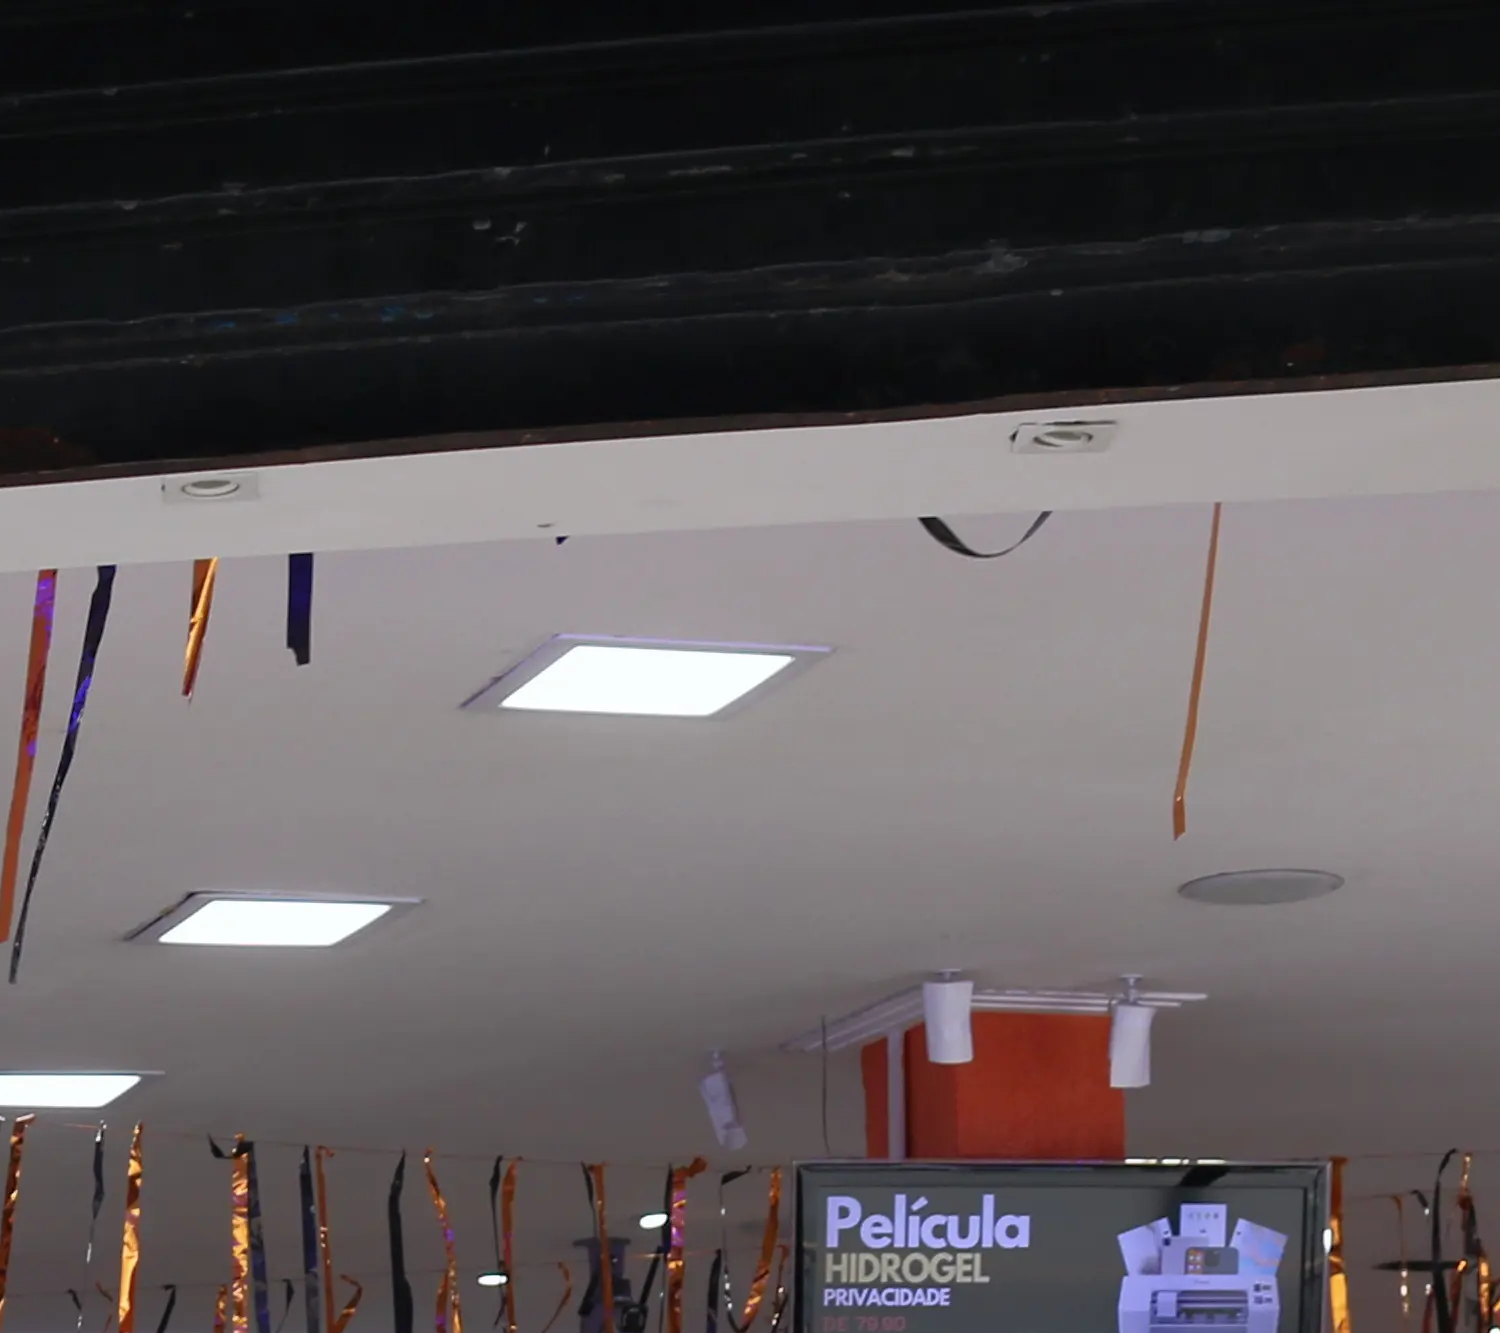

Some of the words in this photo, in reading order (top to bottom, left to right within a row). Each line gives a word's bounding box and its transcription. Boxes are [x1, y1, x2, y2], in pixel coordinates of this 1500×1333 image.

[825, 1193, 1031, 1249] Película
[824, 1252, 990, 1284] HIDROGEL
[822, 1287, 951, 1307] PRIVACIDADE
[821, 1317, 847, 1332] DE
